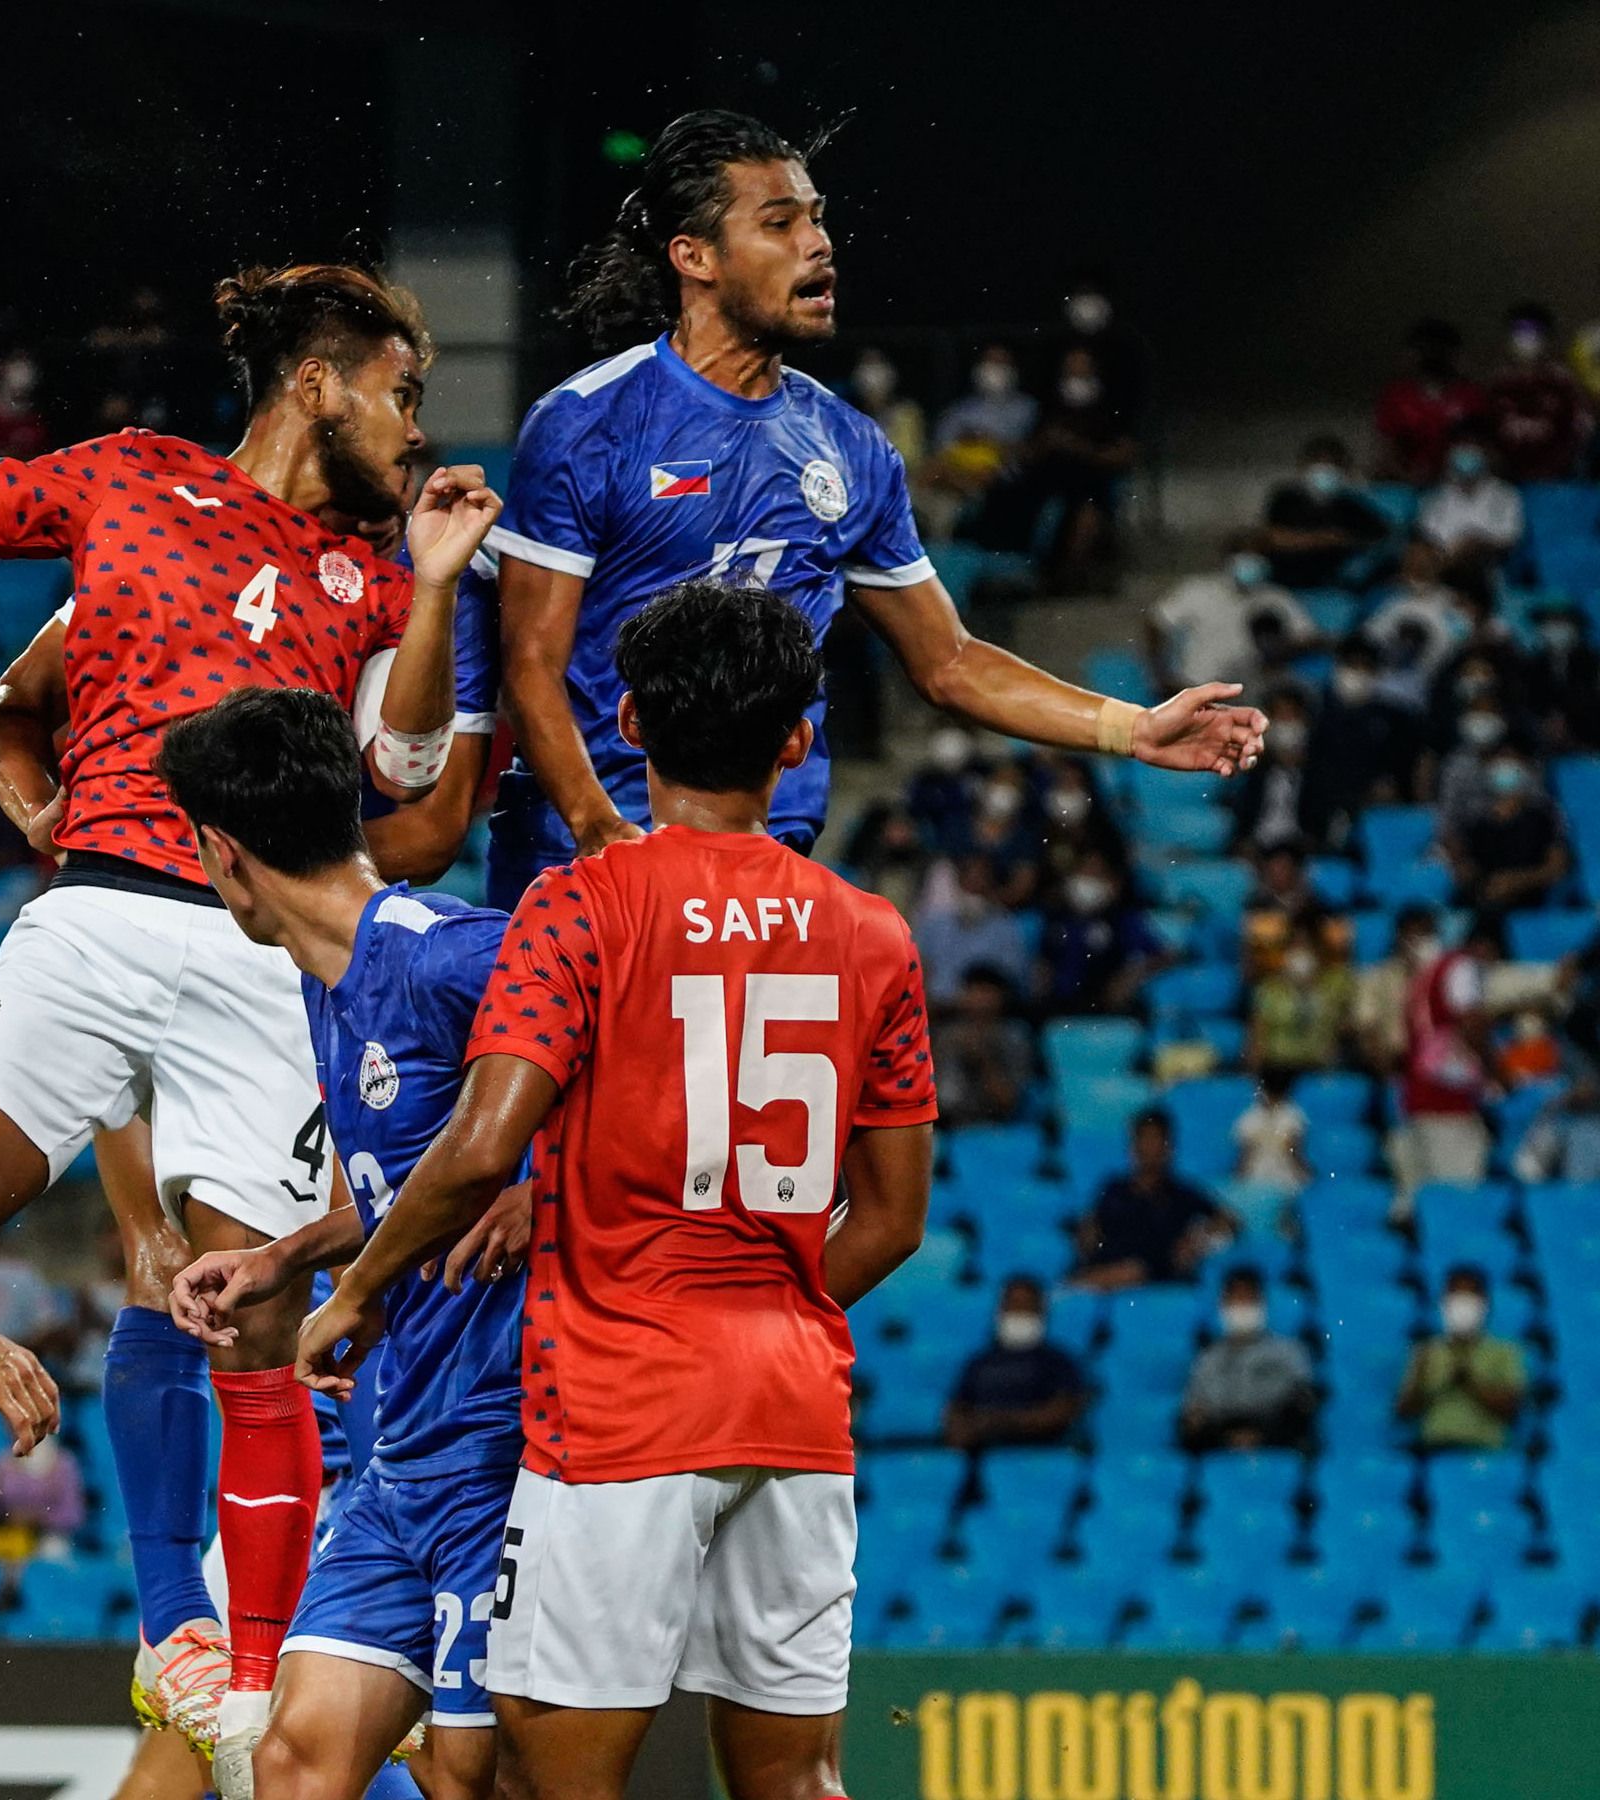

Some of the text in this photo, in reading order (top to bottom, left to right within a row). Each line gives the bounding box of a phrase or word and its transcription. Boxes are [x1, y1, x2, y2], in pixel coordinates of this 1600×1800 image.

[232, 563, 280, 644] 4
[682, 897, 814, 943] SAFY
[365, 1076, 388, 1093] PFF
[671, 973, 839, 1214] 15
[292, 1101, 326, 1184] 4
[434, 1591, 497, 1689] 23
